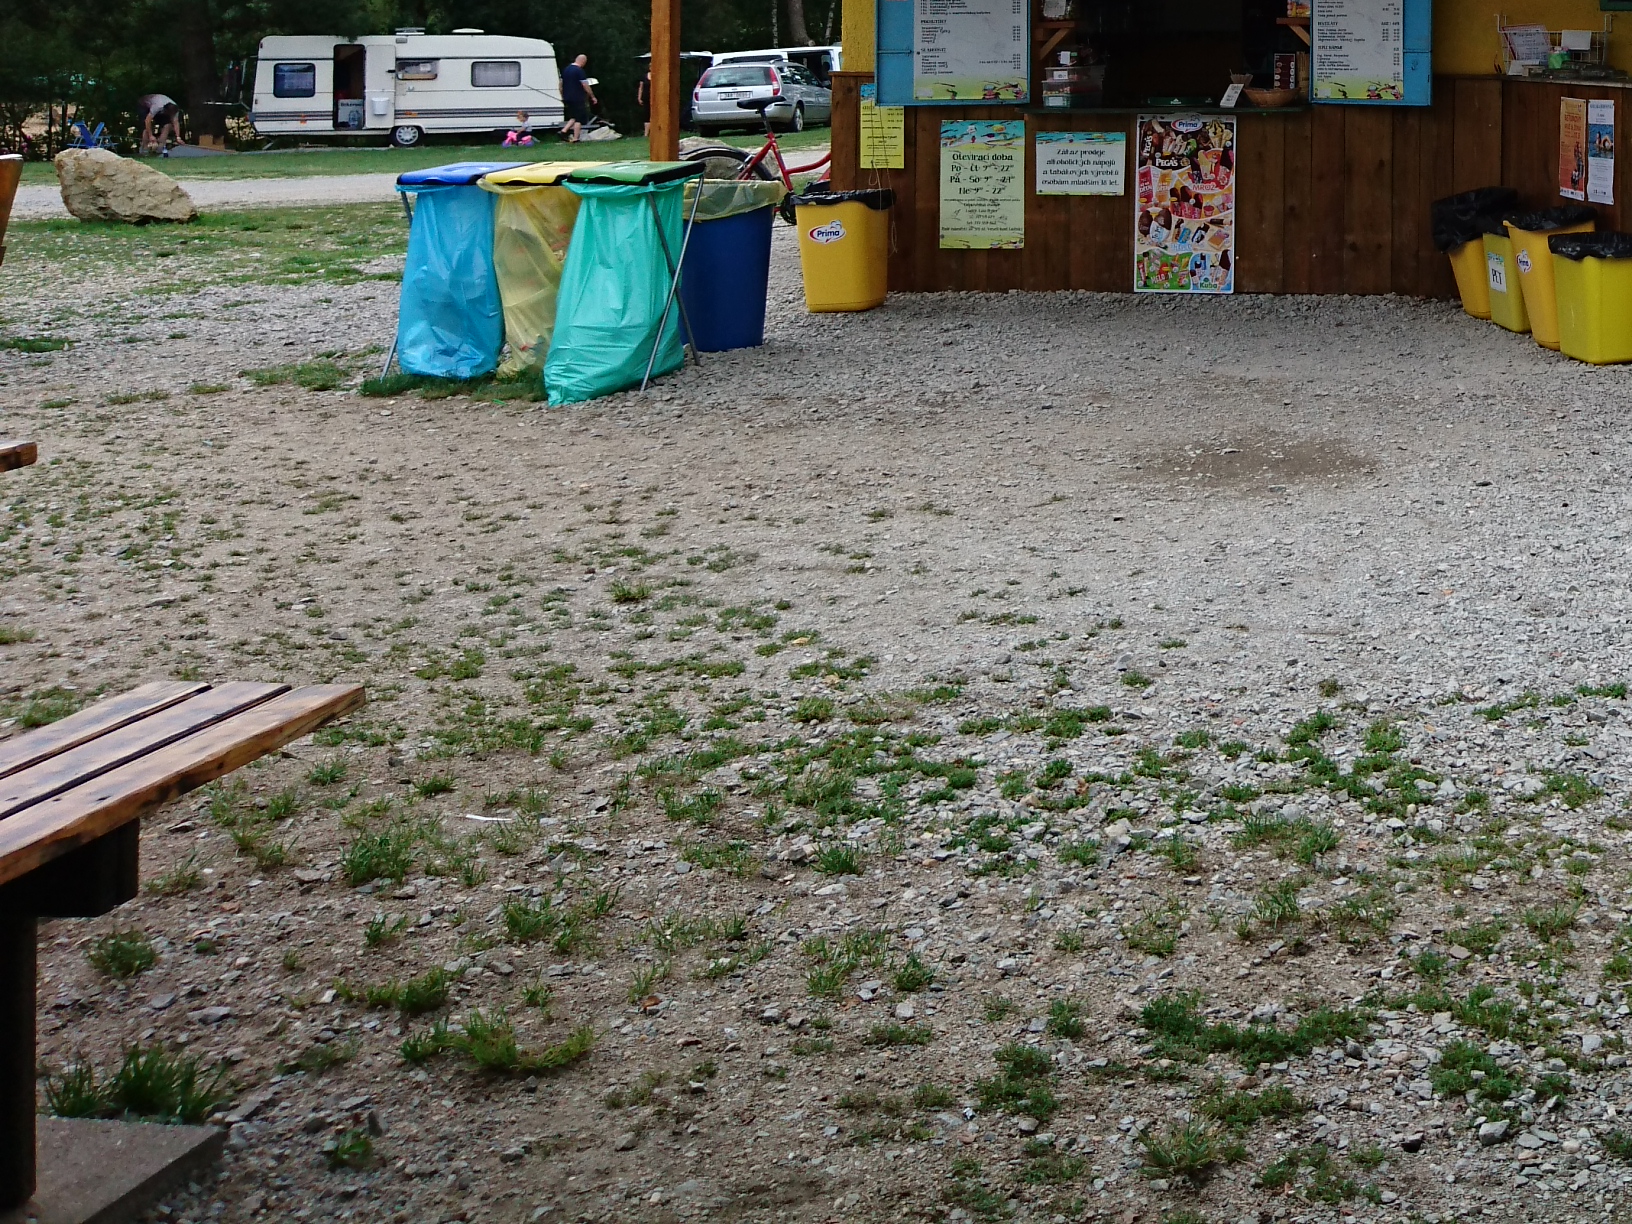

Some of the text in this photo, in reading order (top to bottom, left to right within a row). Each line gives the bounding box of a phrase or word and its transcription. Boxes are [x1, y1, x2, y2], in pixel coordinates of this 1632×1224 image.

[1178, 121, 1198, 129] Prima
[992, 153, 1013, 161] doba
[1192, 183, 1216, 191] MROŽ
[817, 230, 839, 238] Prima
[1199, 282, 1218, 290] Kuba
